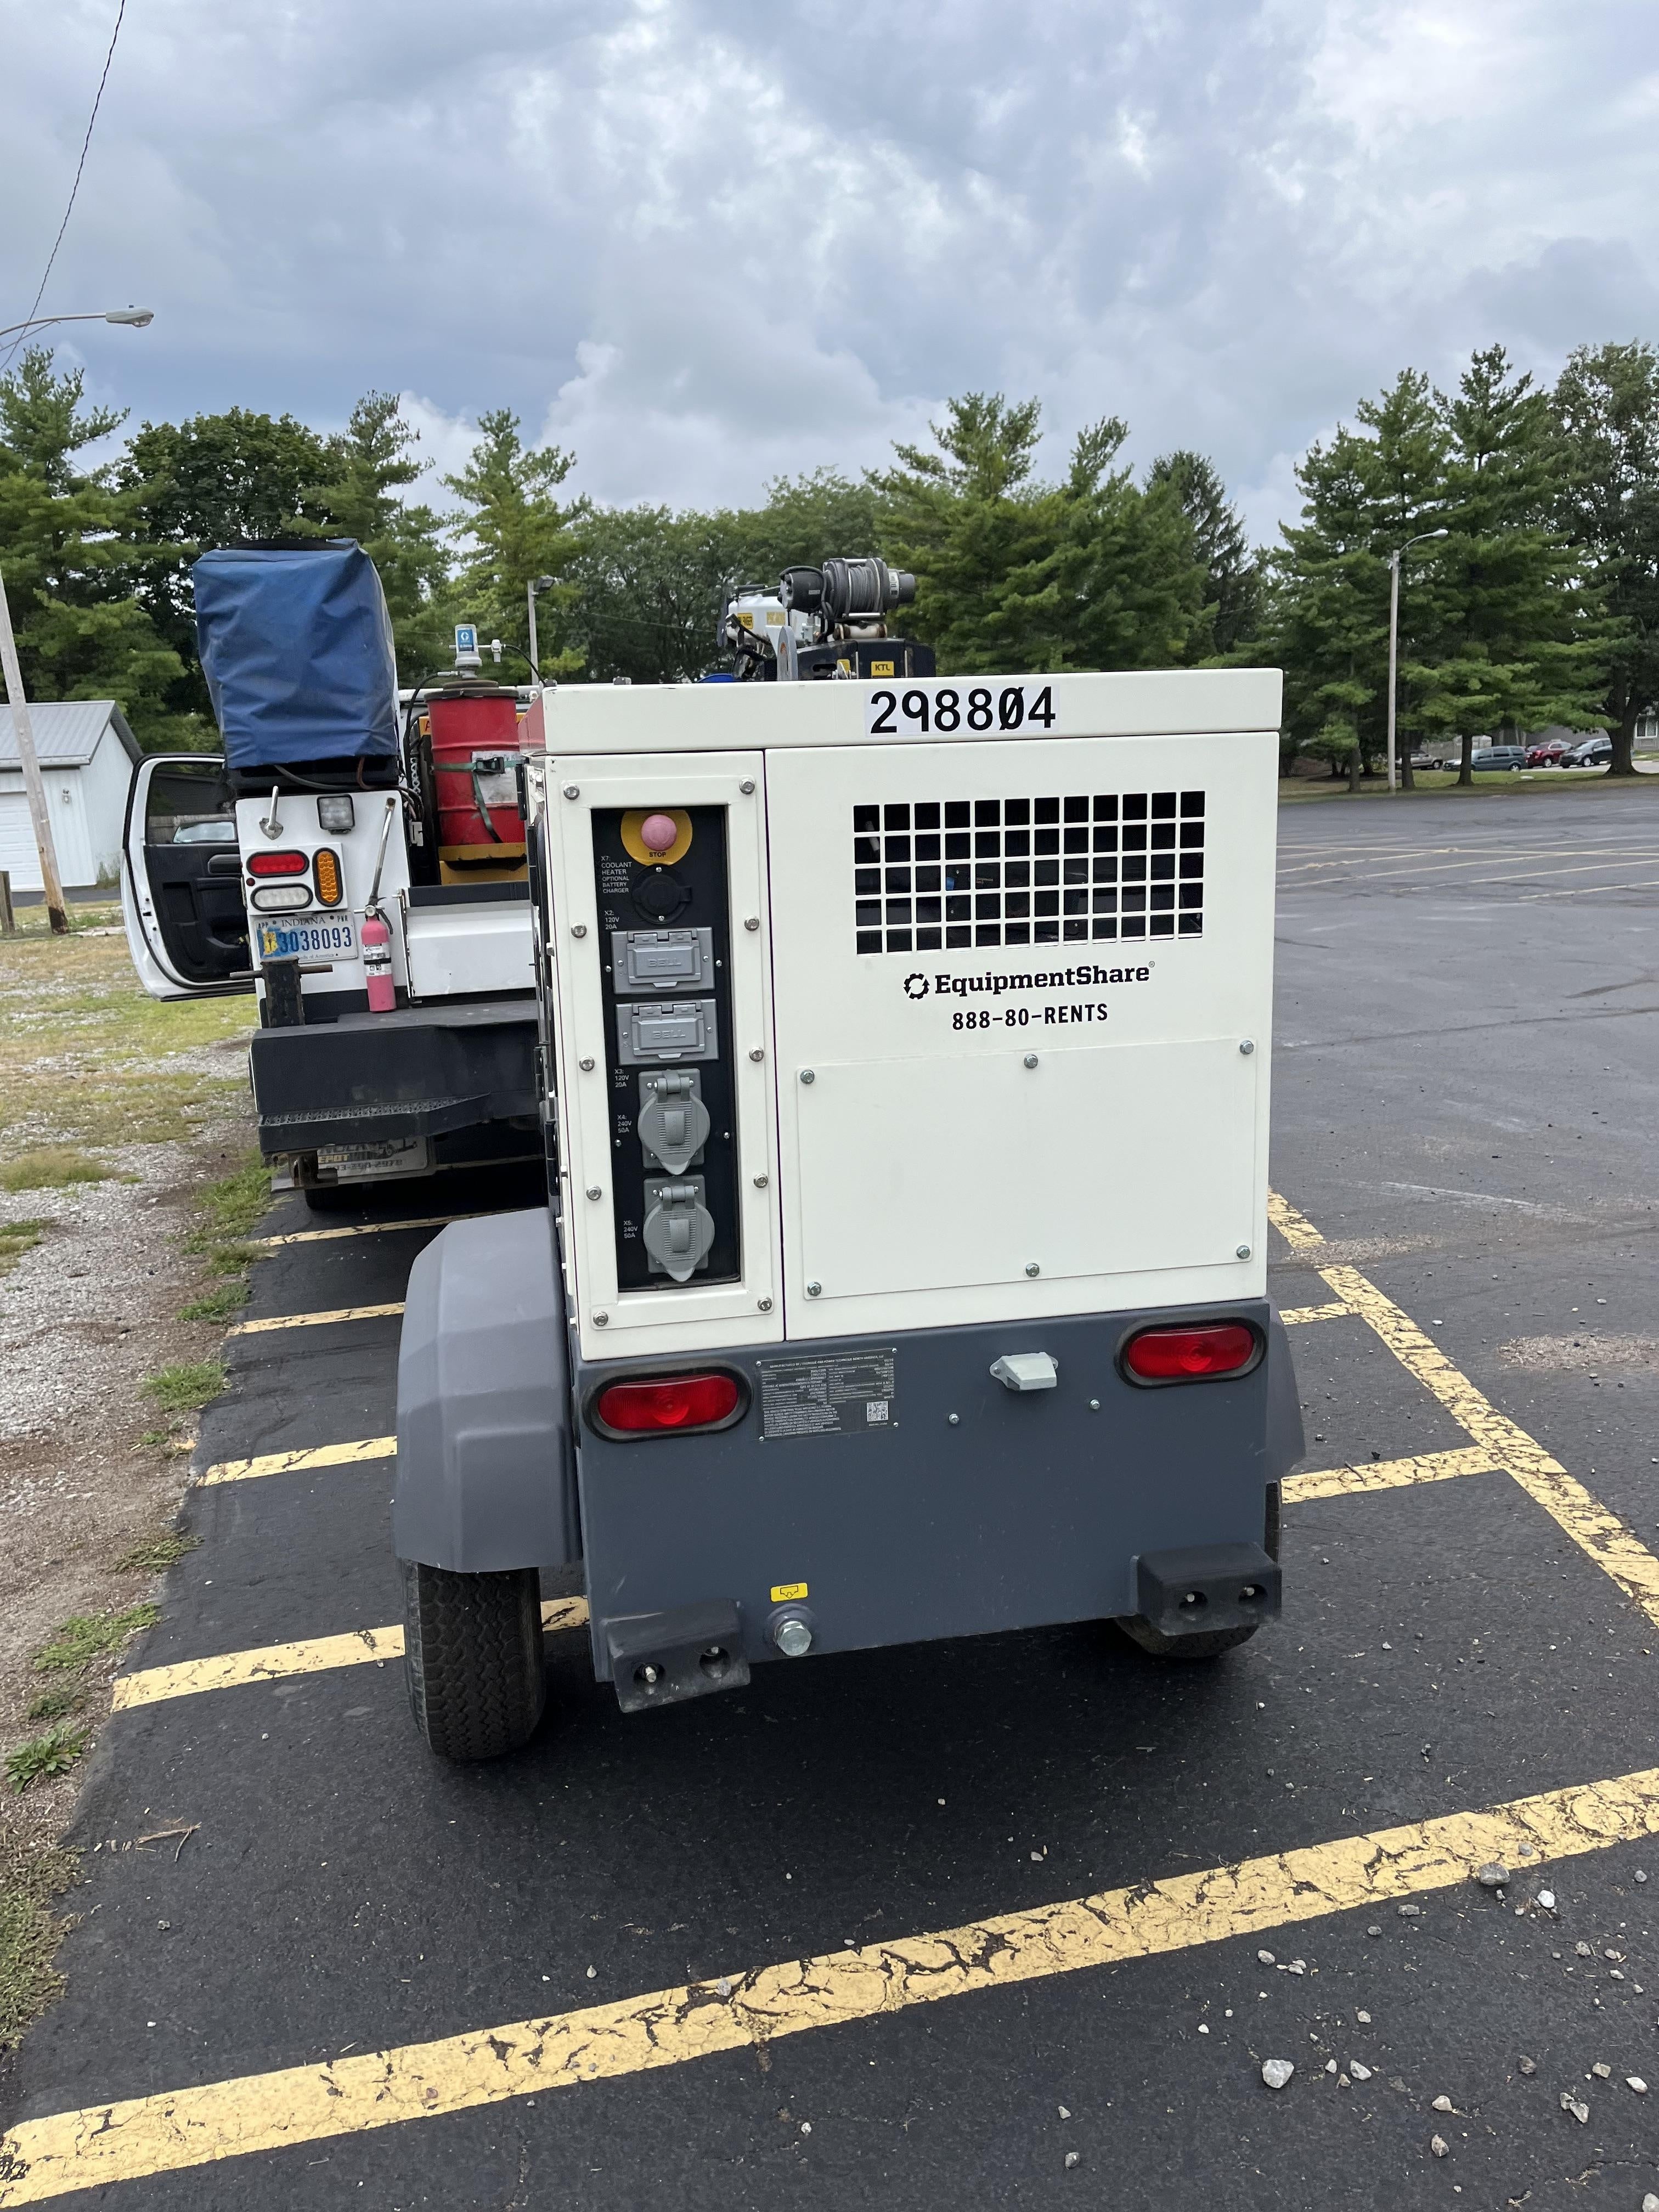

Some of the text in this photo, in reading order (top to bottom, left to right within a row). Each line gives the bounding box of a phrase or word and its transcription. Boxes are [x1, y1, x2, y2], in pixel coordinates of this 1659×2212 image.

[871, 686, 1056, 734] 298804
[281, 917, 325, 927] INDIANA
[279, 927, 352, 953] 3038093
[647, 958, 682, 968] BELL
[952, 1003, 1108, 1030] 888-80-RENTS
[652, 1029, 686, 1040] BELL
[318, 1154, 349, 1164] EPOT
